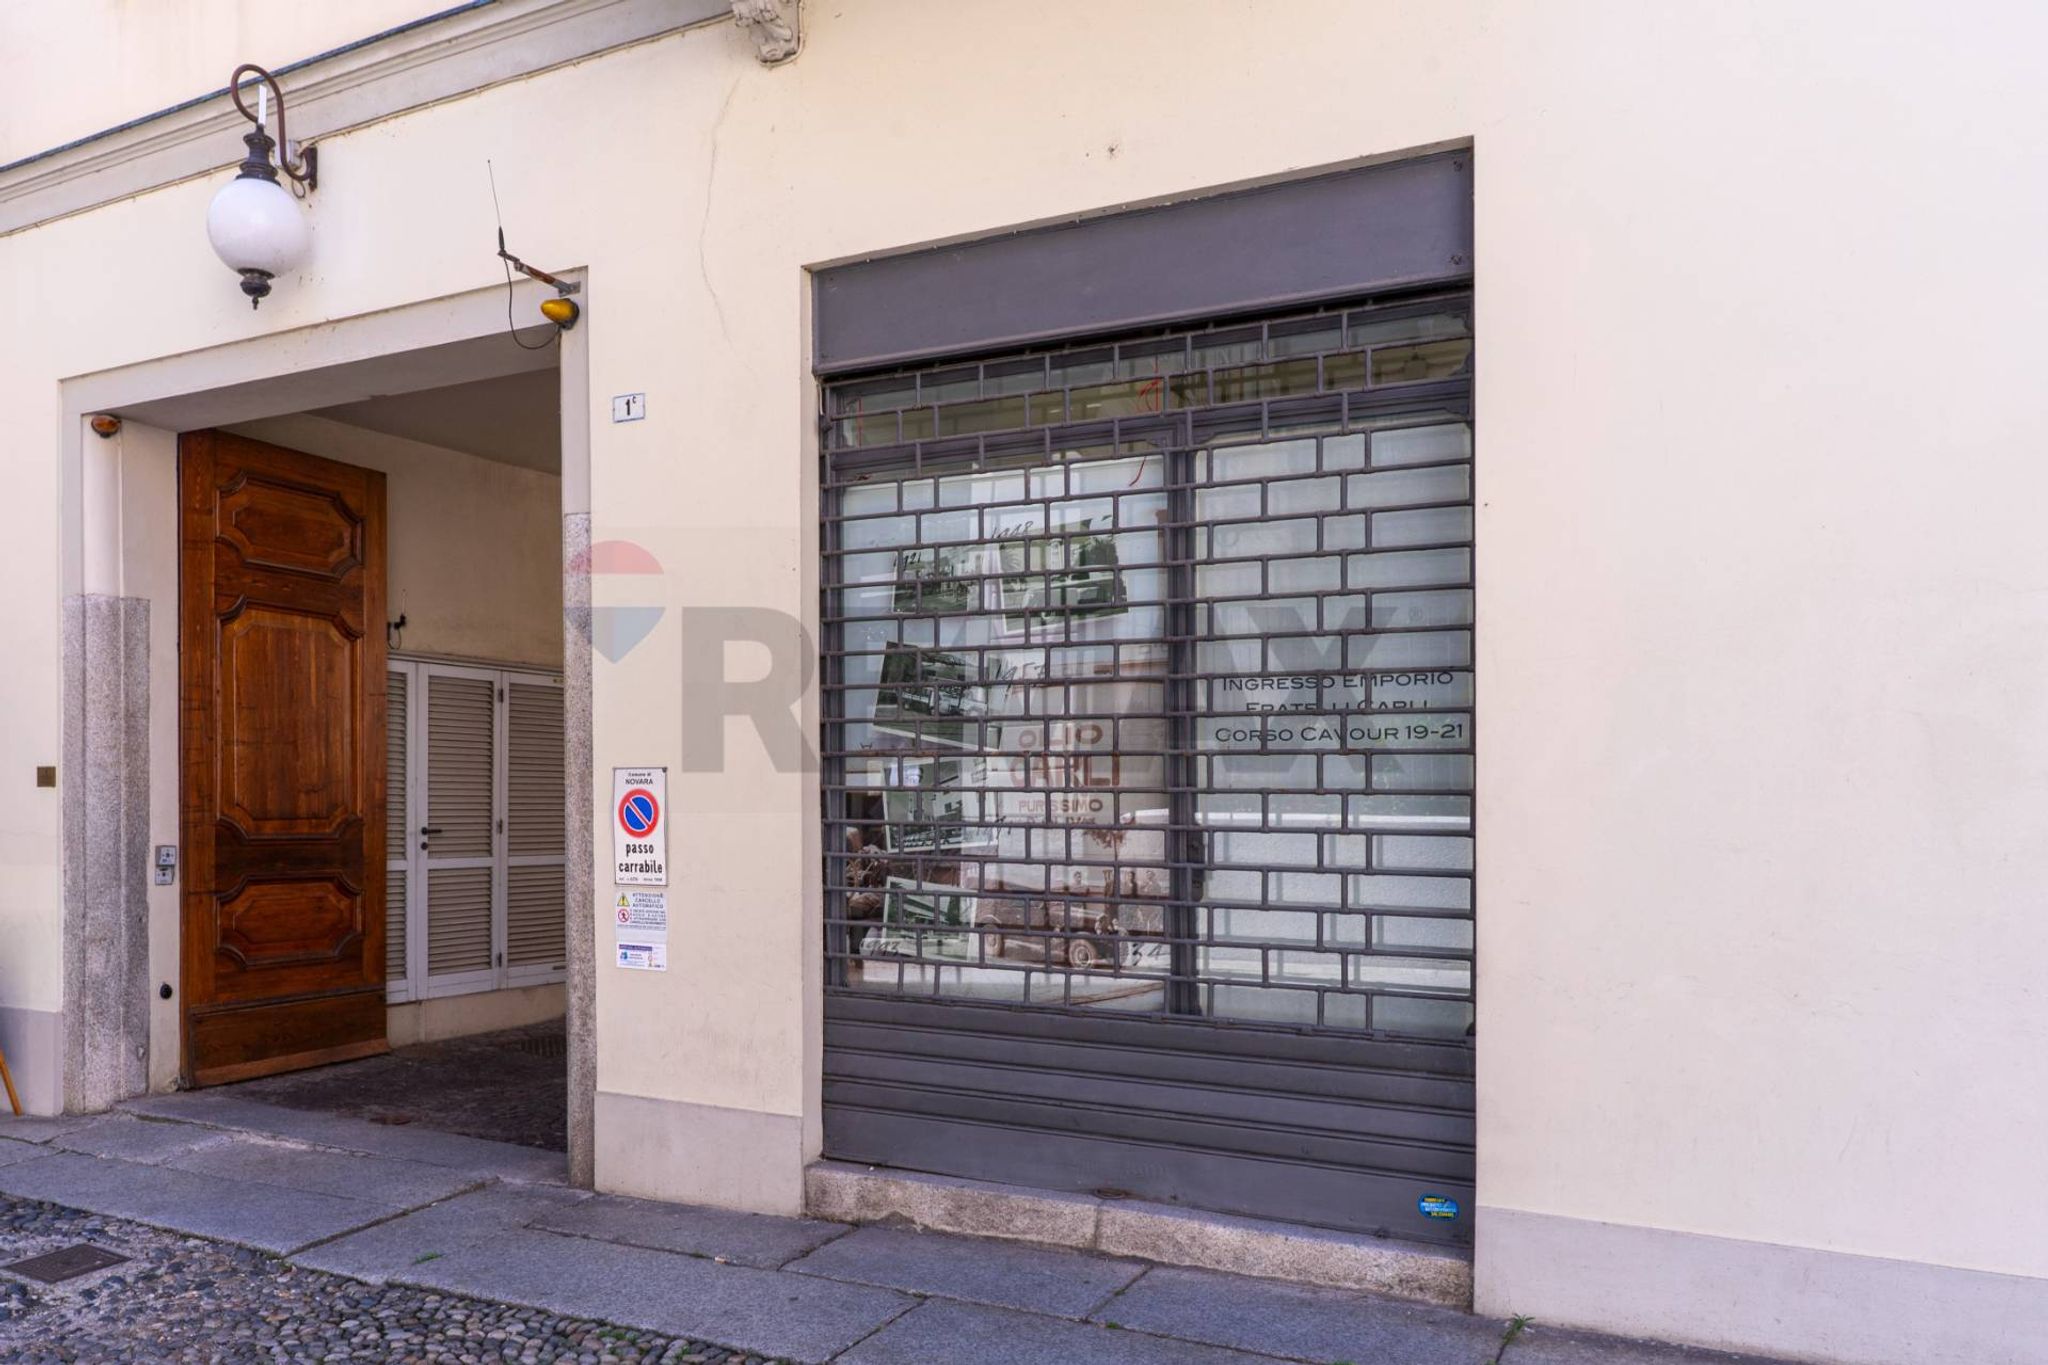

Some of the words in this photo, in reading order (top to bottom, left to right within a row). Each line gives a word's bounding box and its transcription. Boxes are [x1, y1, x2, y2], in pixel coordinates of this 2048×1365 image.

[1223, 676, 1336, 691] INGRESSO
[1343, 671, 1454, 688] EMPORIO
[1246, 701, 1350, 711] FRATELI
[1215, 727, 1293, 742] CORSO
[1300, 726, 1400, 742] CAVOUR
[1405, 723, 1463, 740] 19-21
[1009, 752, 1119, 788] CARLI
[1018, 799, 1104, 812] PURSSIMO
[625, 844, 654, 857] passo
[618, 859, 663, 874] carrabile
